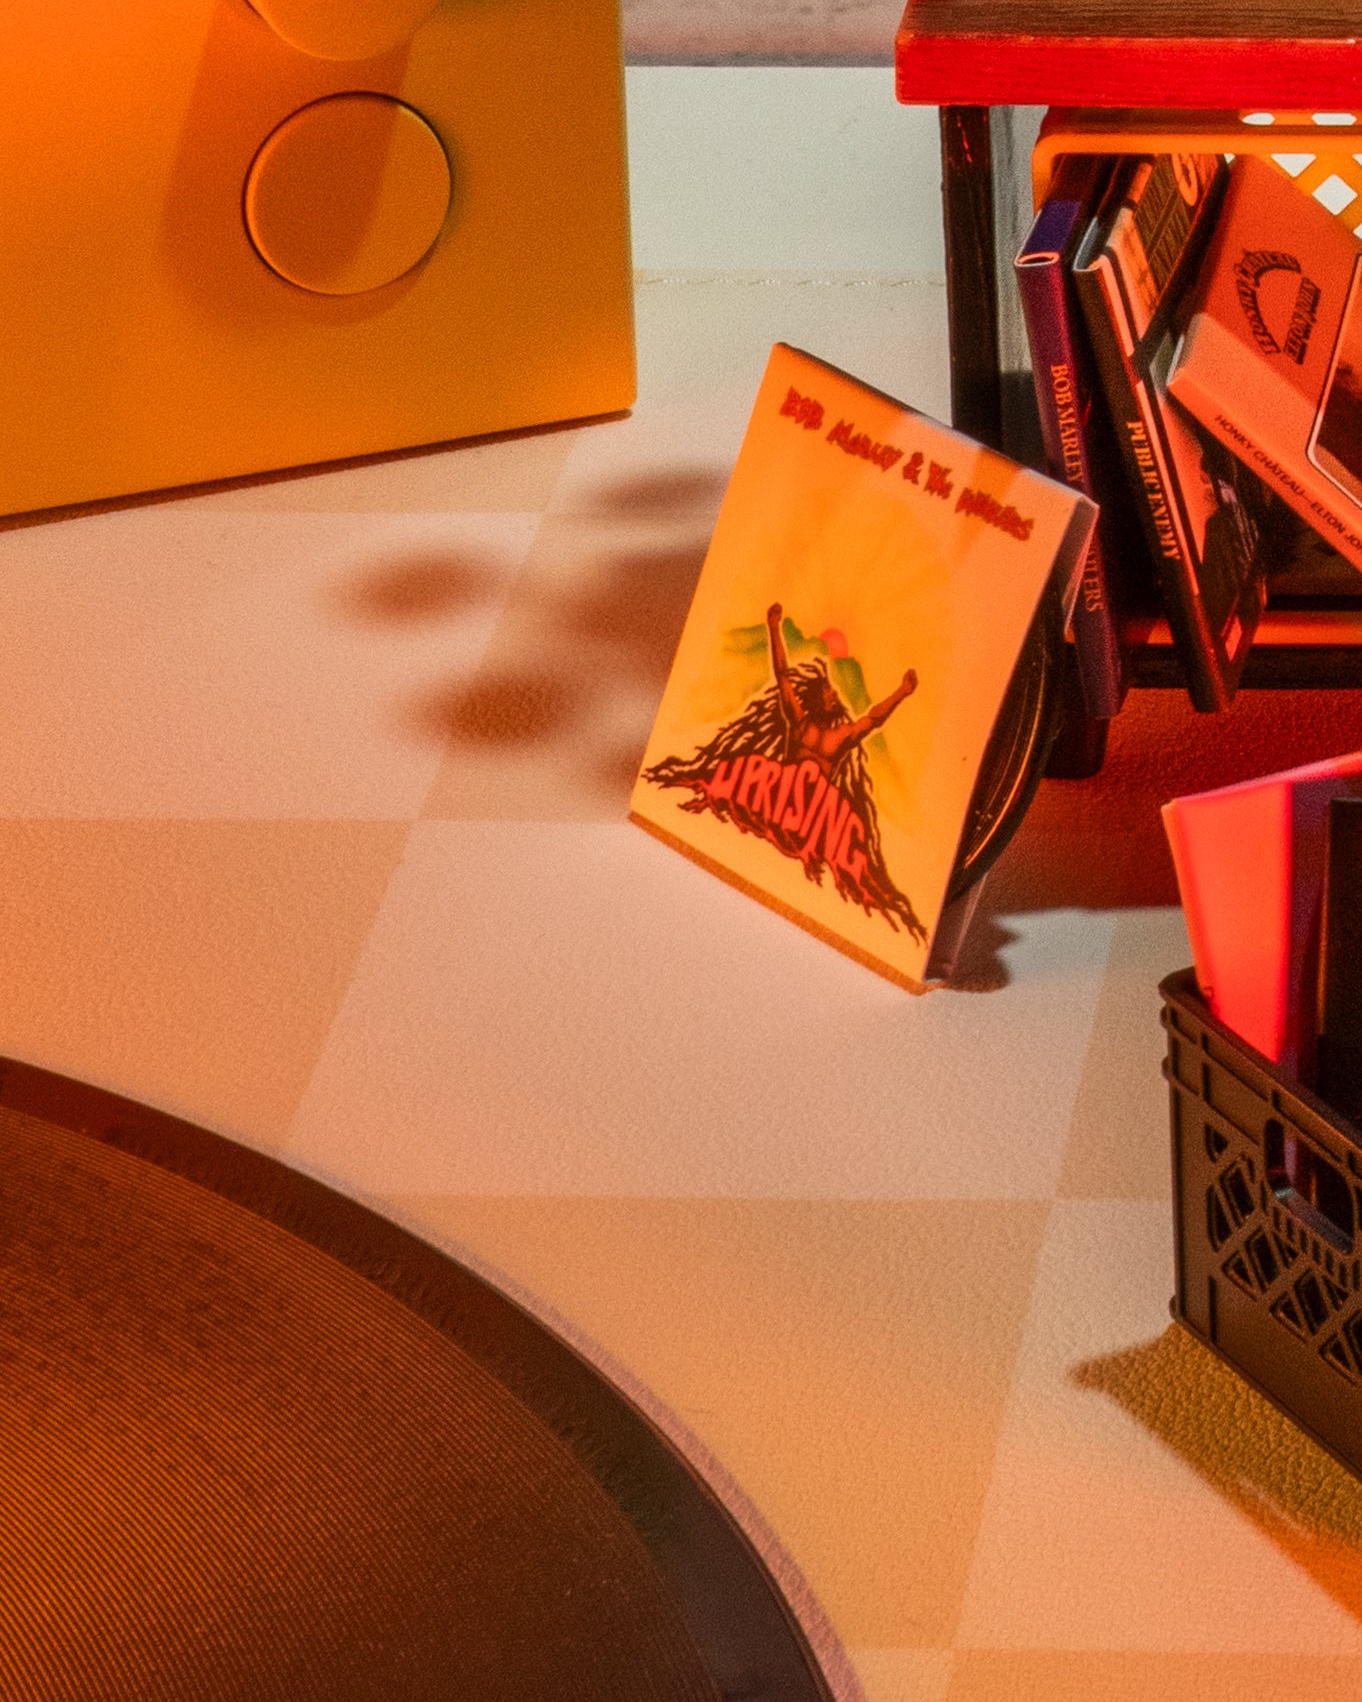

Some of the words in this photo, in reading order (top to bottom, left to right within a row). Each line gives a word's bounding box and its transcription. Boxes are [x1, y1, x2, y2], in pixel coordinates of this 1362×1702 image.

[1050, 363, 1073, 403] BOB
[1057, 404, 1085, 483] MARLEY
[1213, 413, 1254, 451] HONKY
[1126, 420, 1162, 491] PUBLIC
[1146, 492, 1181, 561] ENEMY
[708, 753, 869, 882] UPRISING
